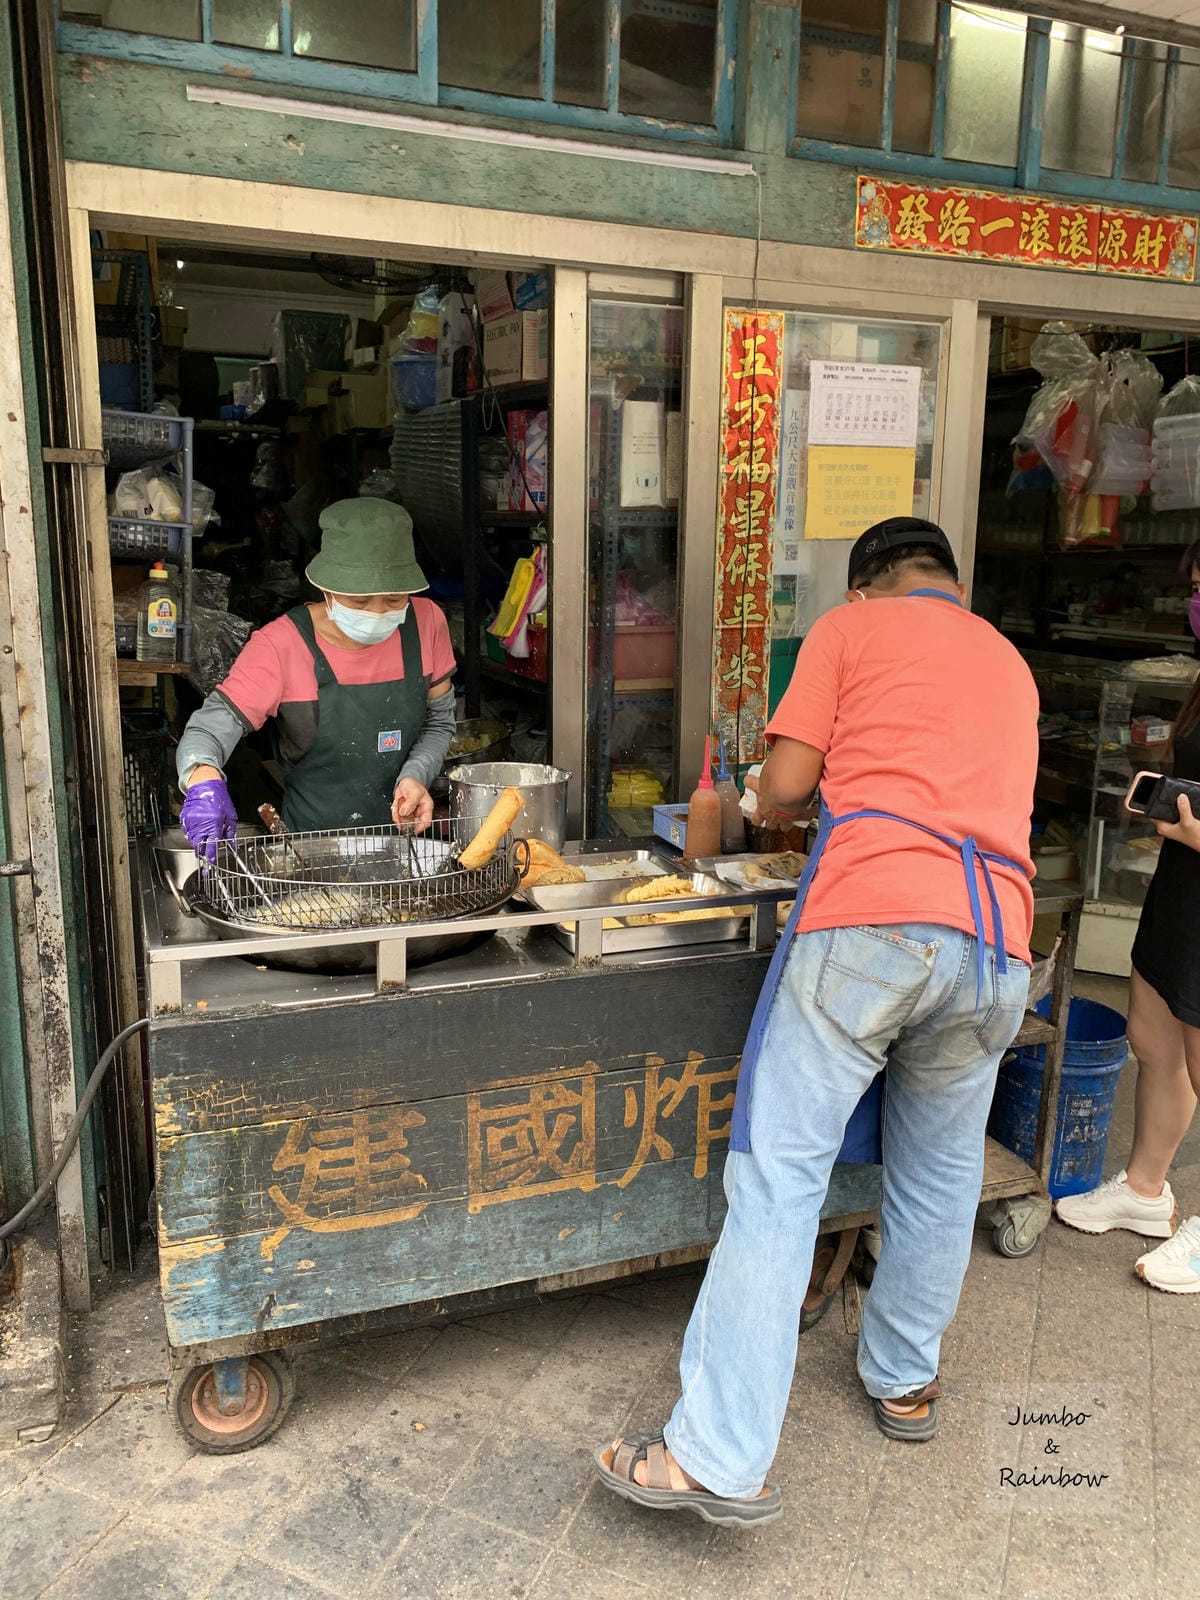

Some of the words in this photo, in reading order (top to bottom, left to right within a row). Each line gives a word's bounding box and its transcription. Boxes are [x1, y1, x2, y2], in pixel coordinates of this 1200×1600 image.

[722, 336, 776, 690] 五方福星保平安
